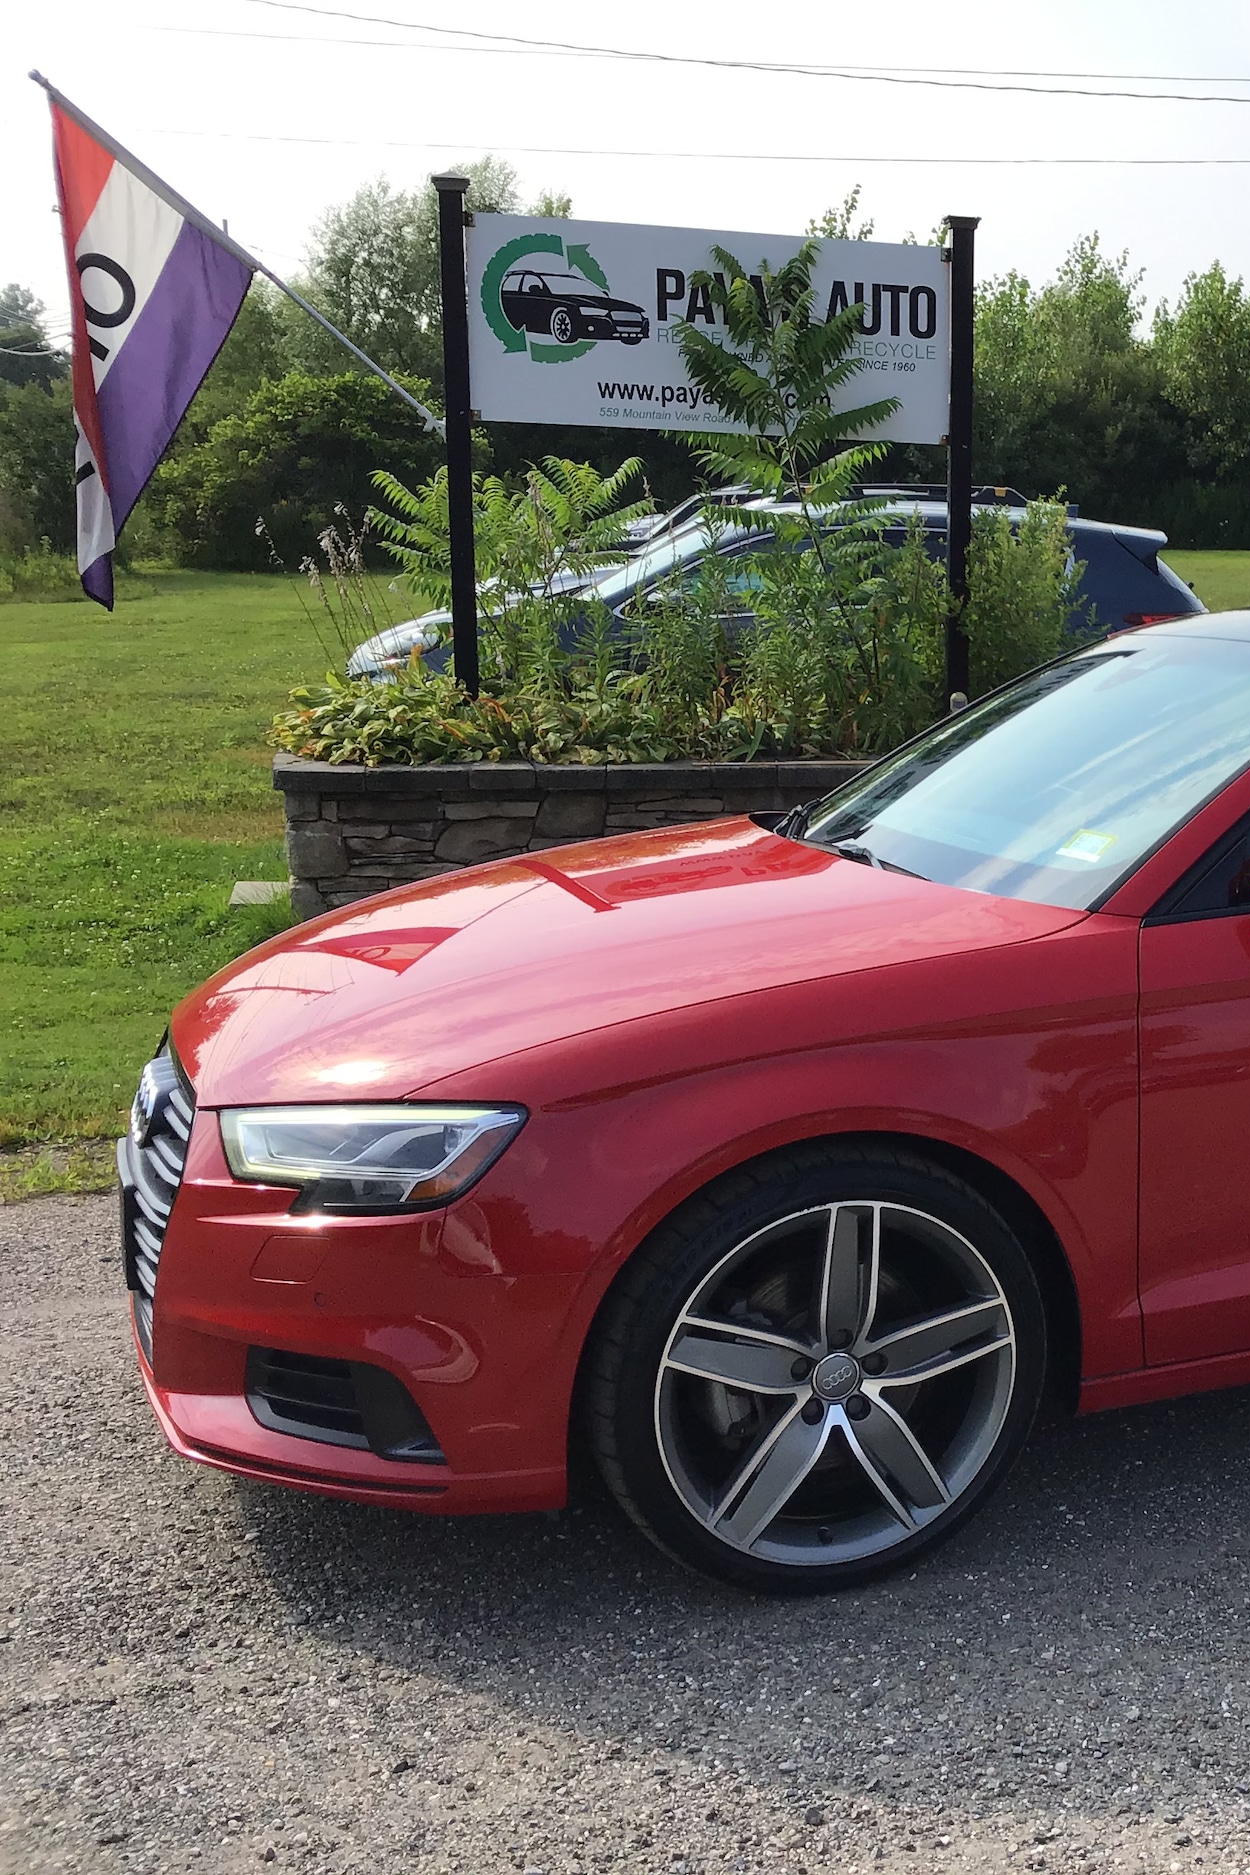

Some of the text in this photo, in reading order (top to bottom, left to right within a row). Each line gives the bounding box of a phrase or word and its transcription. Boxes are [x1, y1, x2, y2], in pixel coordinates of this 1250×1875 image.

[825, 280, 936, 339] AUTO
[850, 340, 936, 360] RECYCLE
[858, 358, 889, 370] INCE
[892, 361, 916, 372] 1960
[599, 407, 619, 418] 559
[622, 408, 671, 420] Mountain
[675, 410, 700, 421] View
